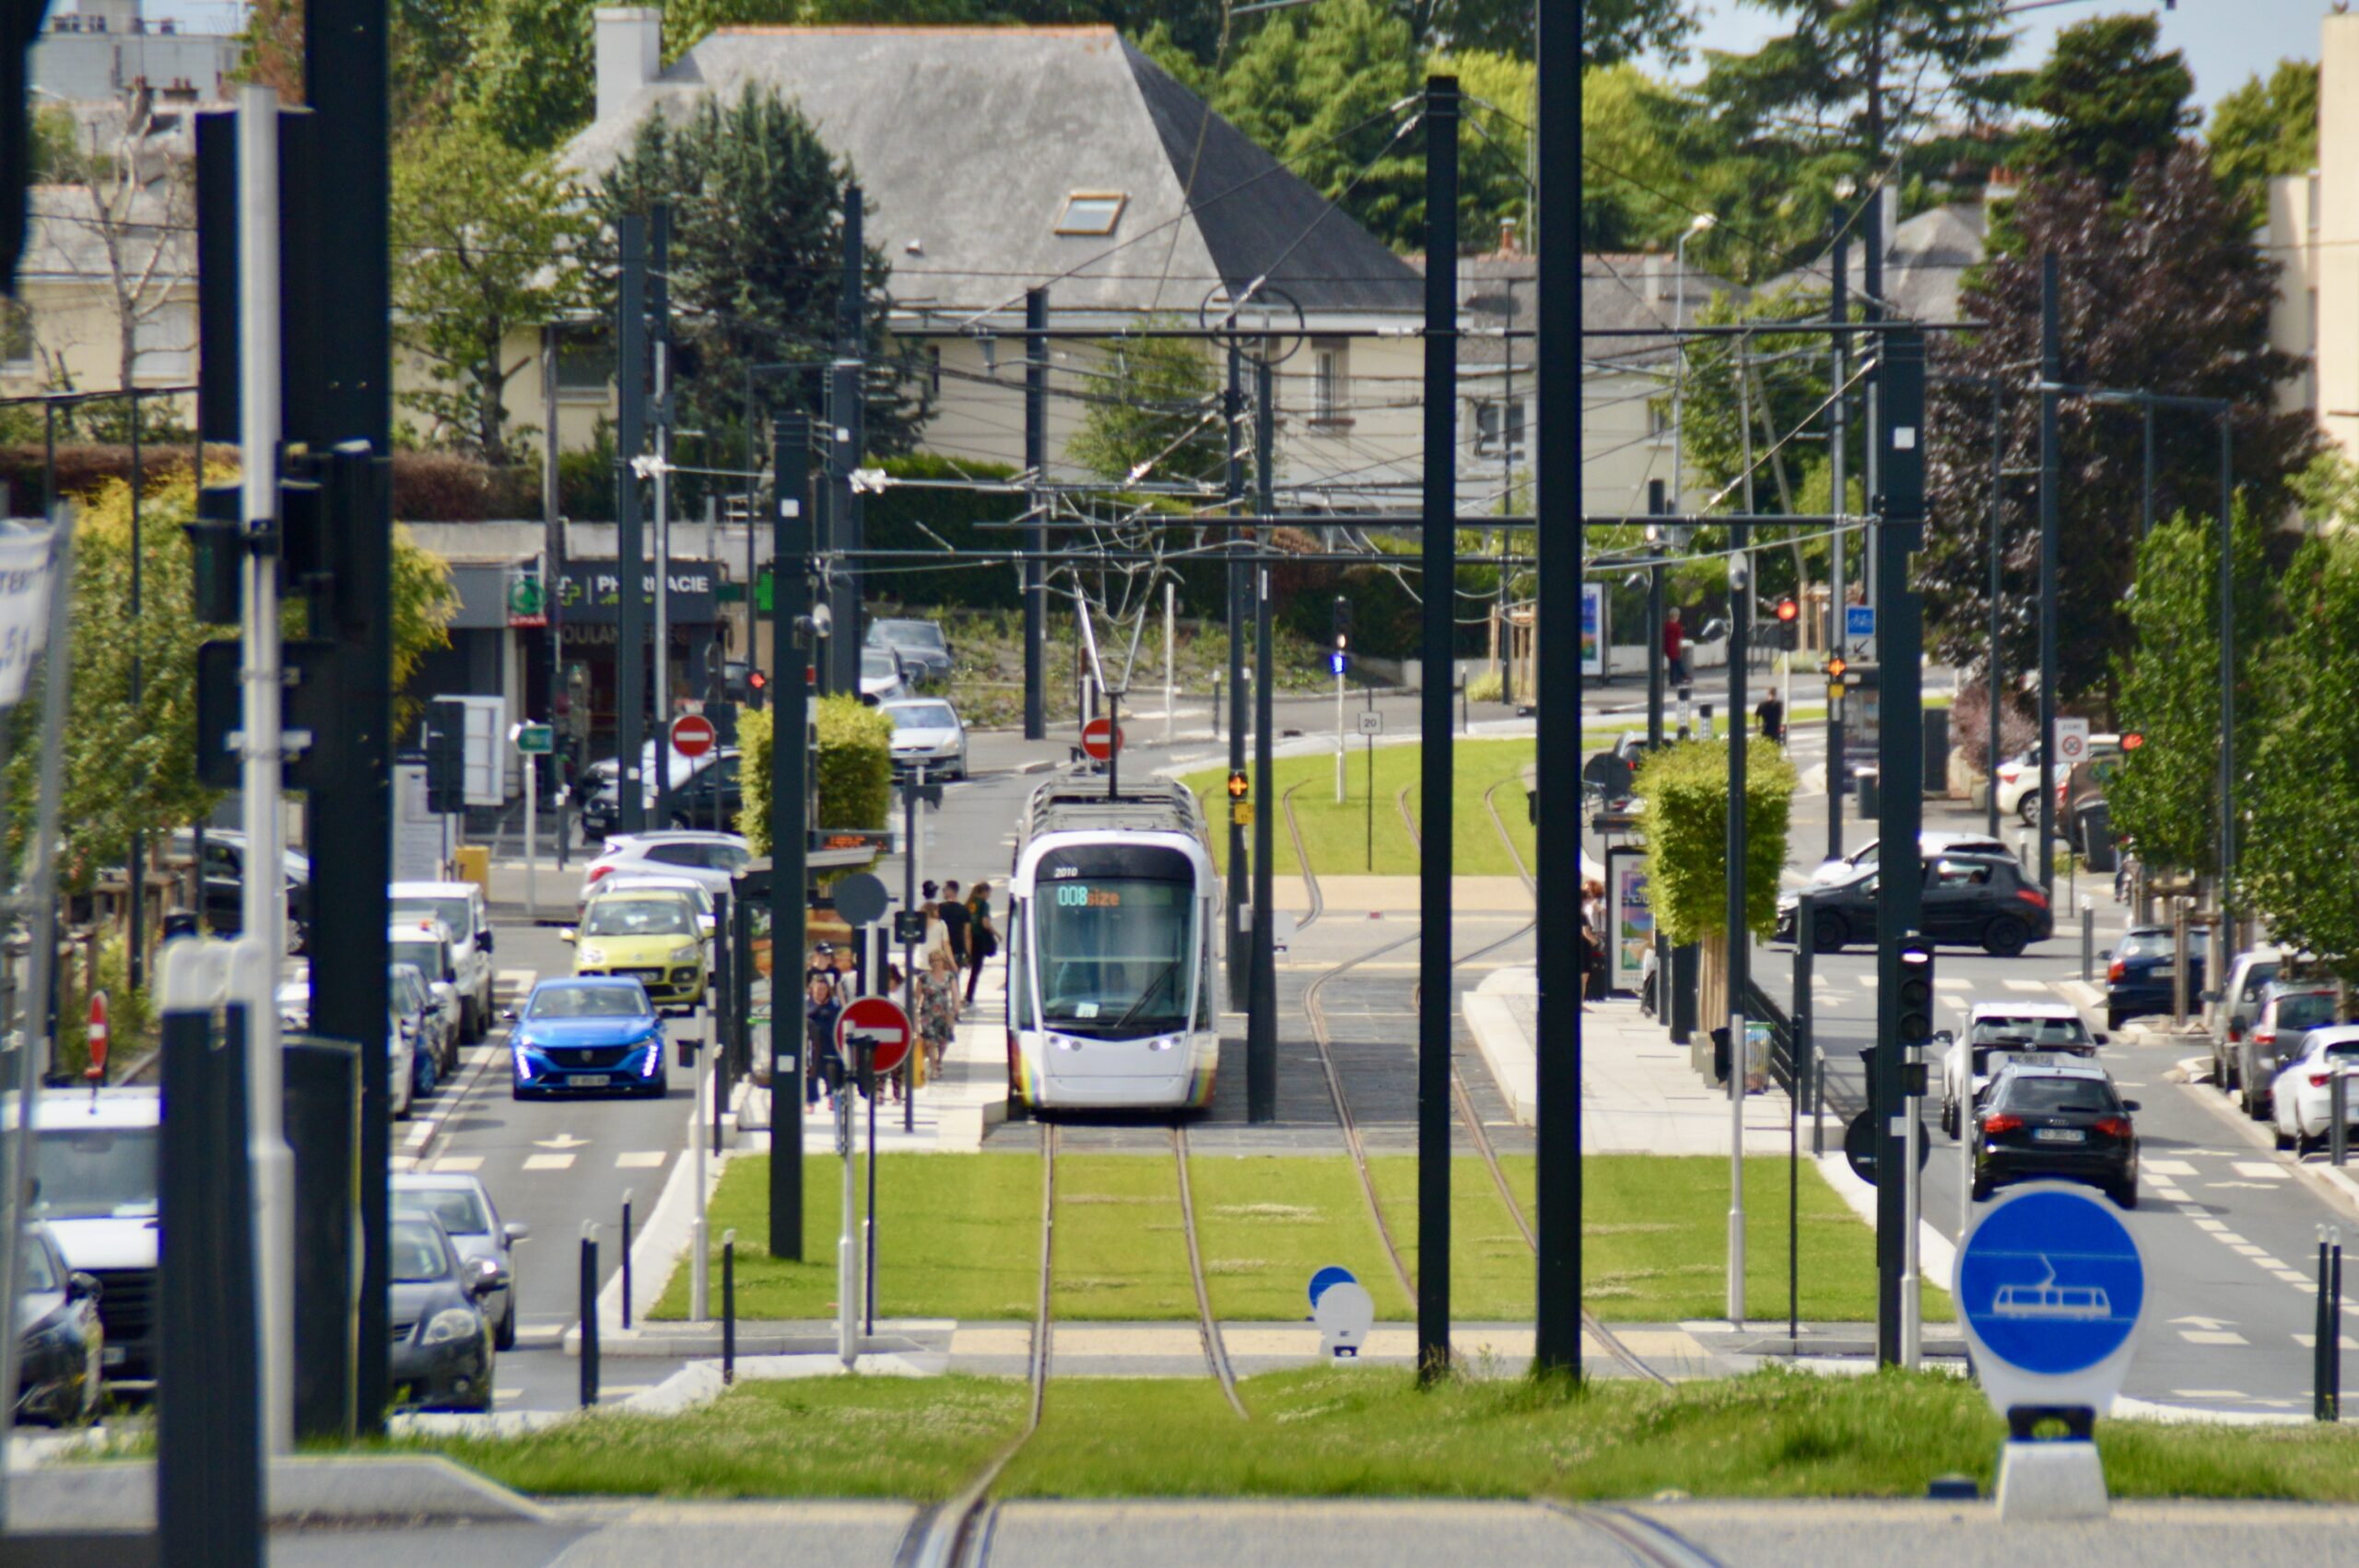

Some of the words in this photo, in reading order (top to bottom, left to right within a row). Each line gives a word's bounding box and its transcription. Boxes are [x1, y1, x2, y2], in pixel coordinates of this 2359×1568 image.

[1364, 718, 1377, 728] 20
[1054, 867, 1078, 878] 2010
[1058, 885, 1087, 907] 008
